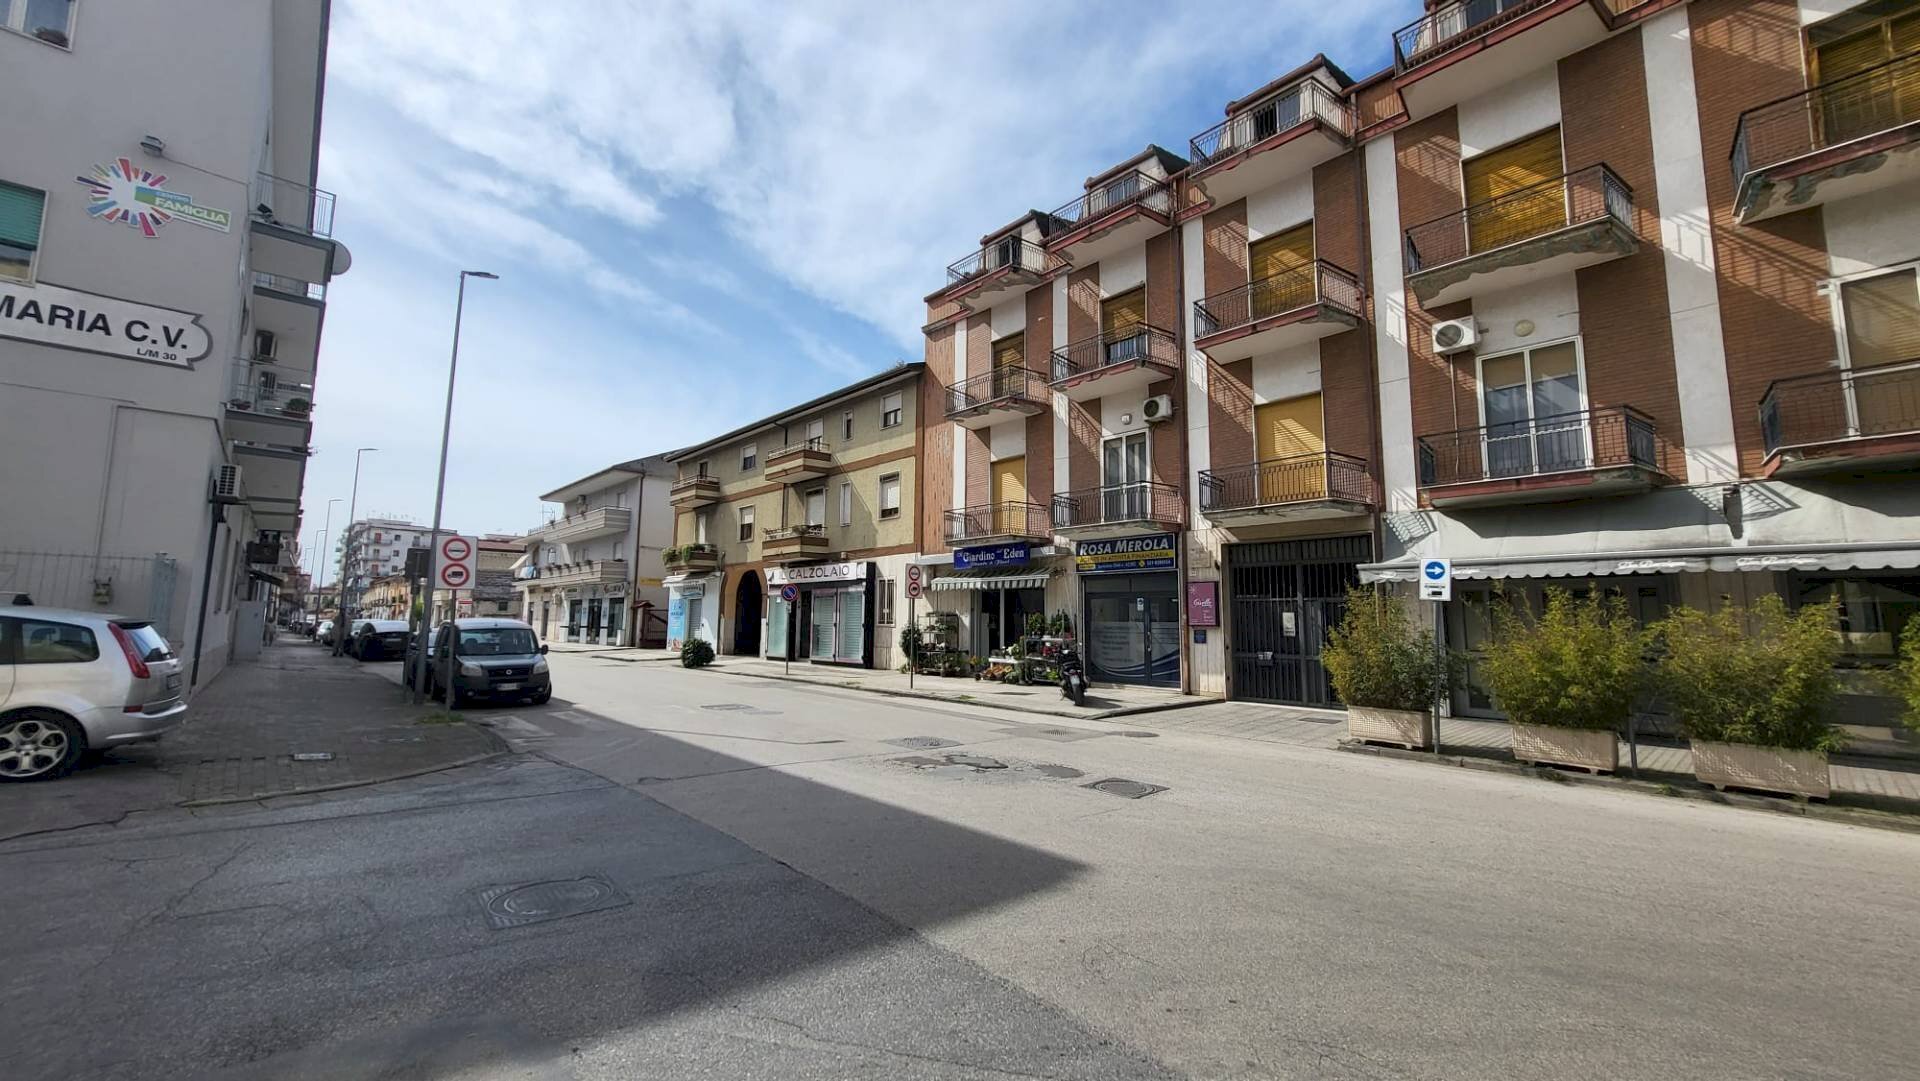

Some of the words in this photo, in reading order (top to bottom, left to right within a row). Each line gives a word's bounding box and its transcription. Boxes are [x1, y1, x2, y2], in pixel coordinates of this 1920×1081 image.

[155, 197, 227, 224] FAMIGLIA
[124, 320, 188, 350] C.V.
[162, 352, 178, 361] 30
[962, 549, 996, 563] Giardino
[1003, 547, 1025, 560] Eden
[1079, 543, 1112, 556] ROSA
[1115, 538, 1169, 553] MEROLA
[788, 565, 850, 580] CALZOLAIO
